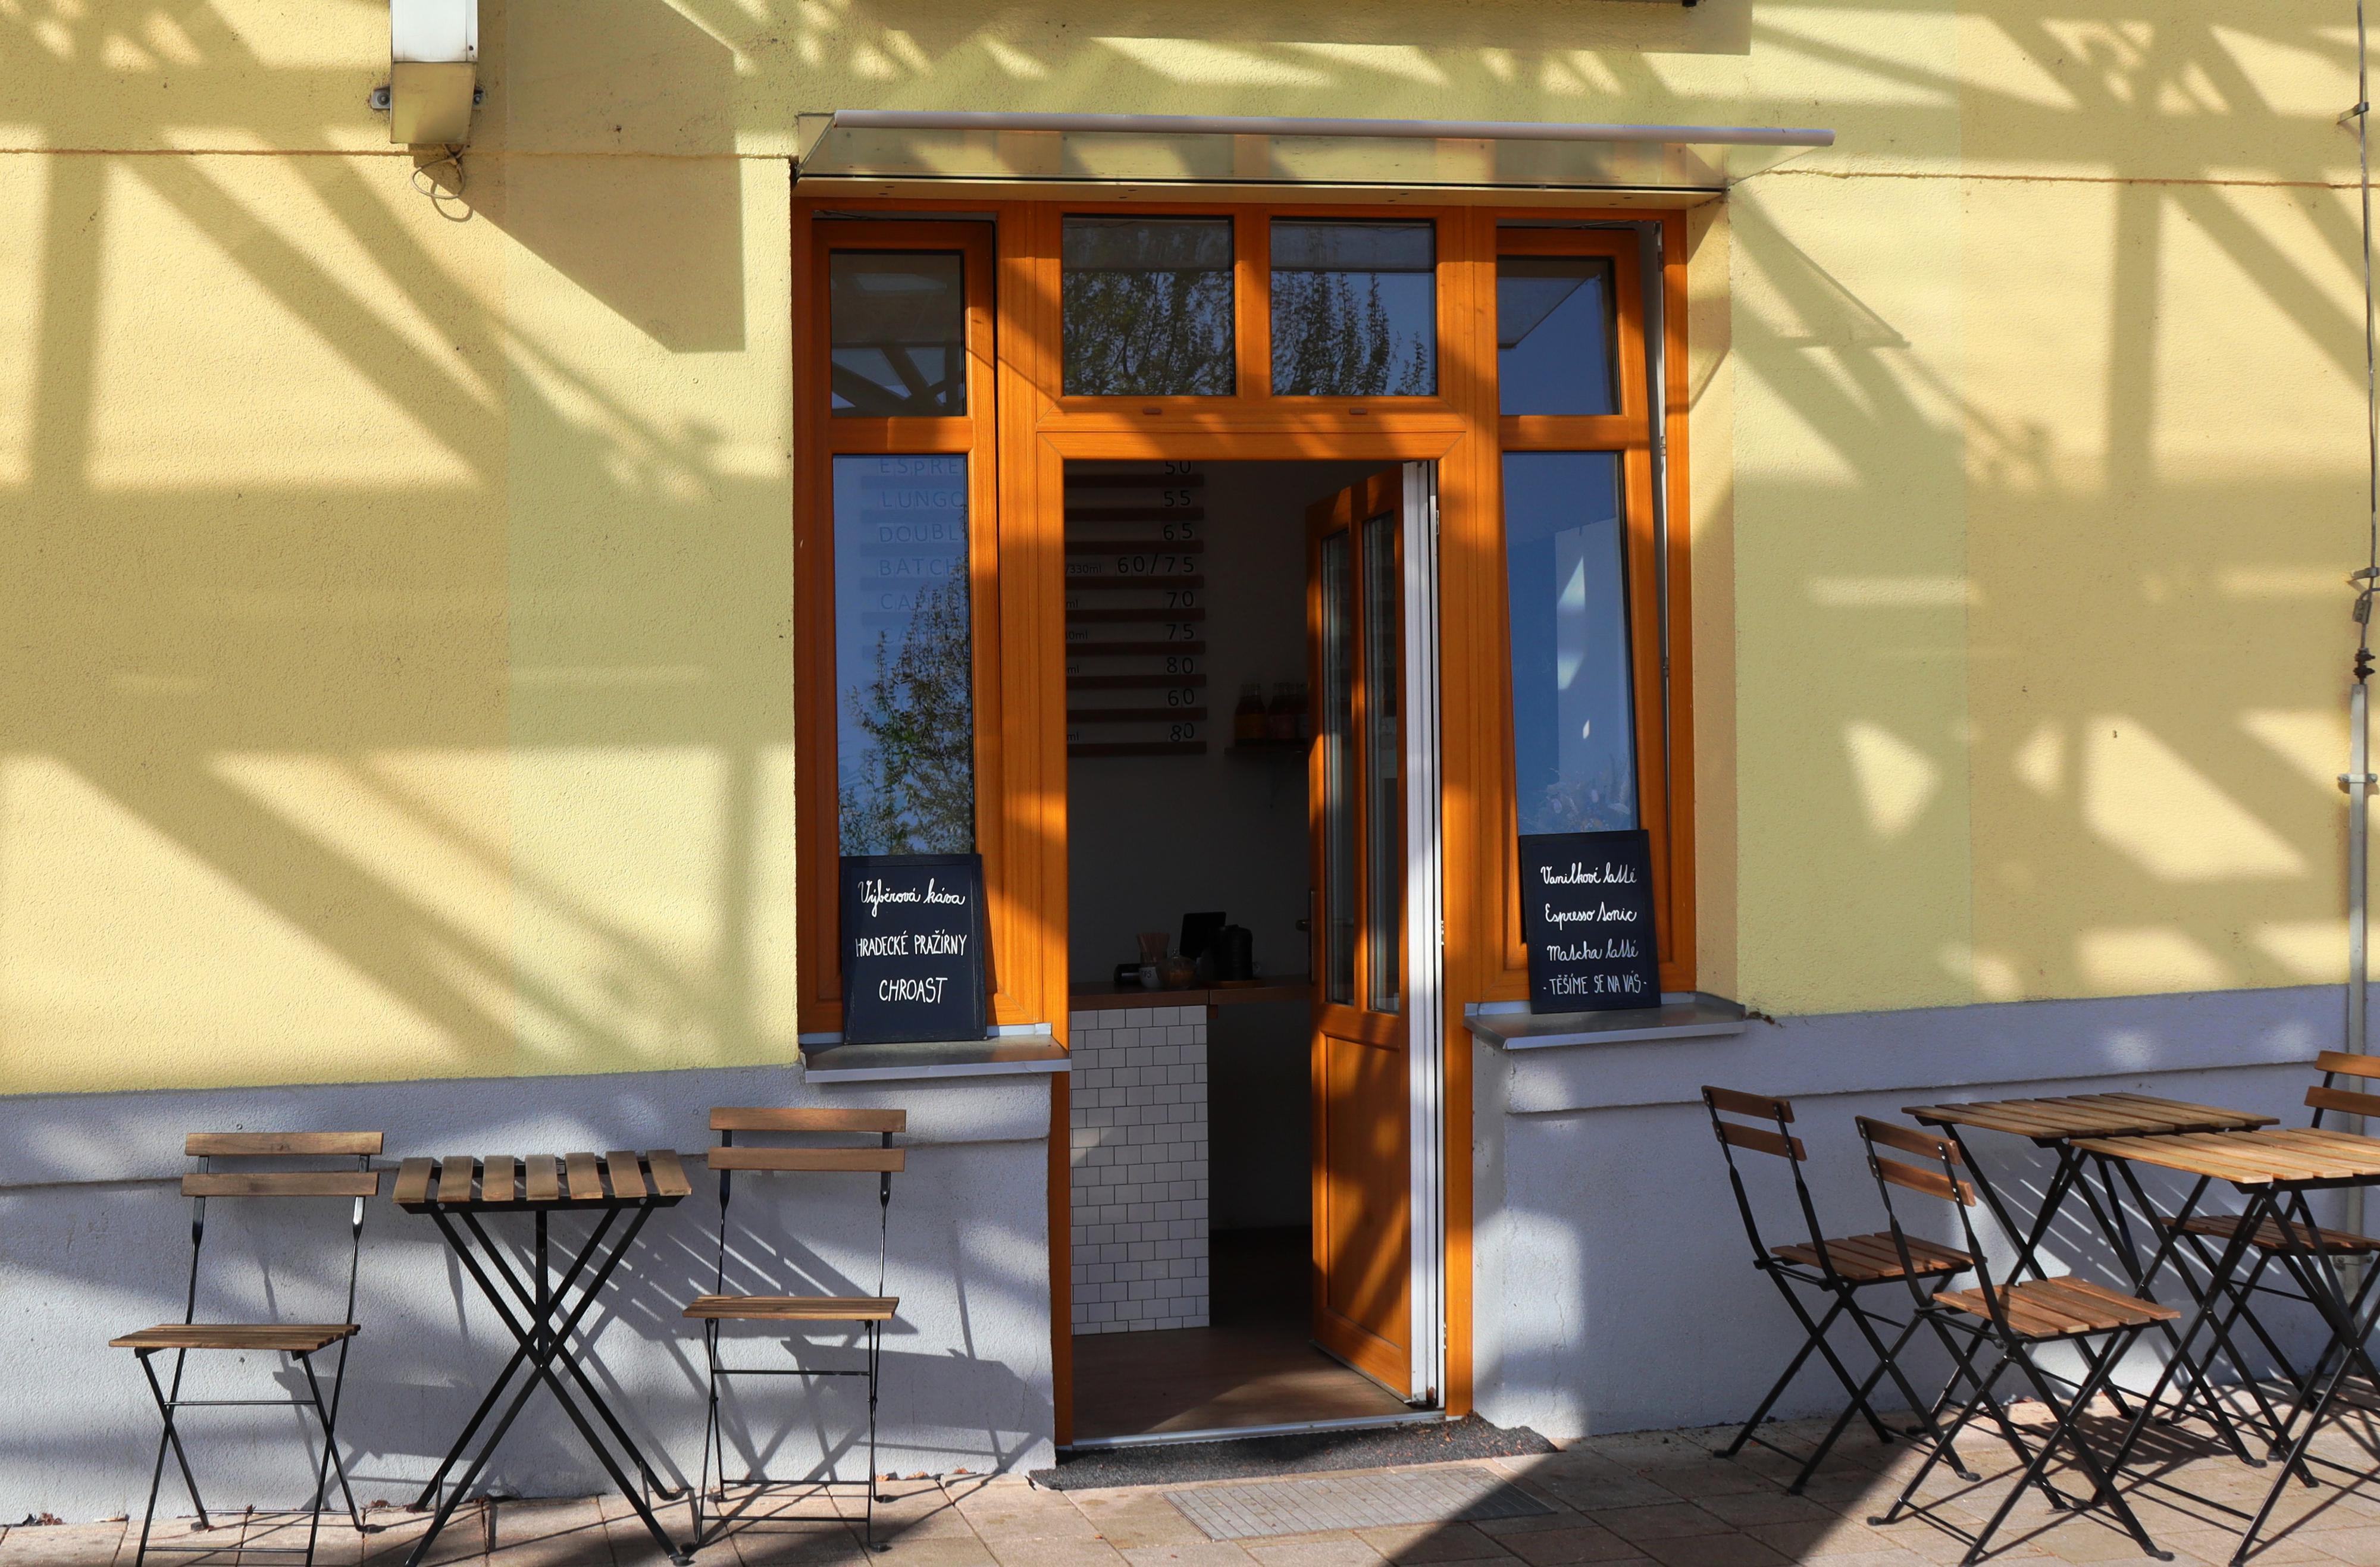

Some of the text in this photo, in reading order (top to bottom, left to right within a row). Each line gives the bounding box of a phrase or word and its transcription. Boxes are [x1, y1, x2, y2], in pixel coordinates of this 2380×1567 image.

[1165, 460, 1191, 475] 50
[1164, 490, 1191, 506] 55
[1163, 523, 1193, 540] 65
[1117, 554, 1194, 574] 60/75
[1166, 591, 1194, 608] 70
[1066, 624, 1194, 640] 0ml 75
[1166, 657, 1194, 674] 80
[1168, 689, 1195, 707] 60
[1170, 723, 1194, 742] 80
[857, 878, 966, 917] Výběrová káva
[1545, 903, 1595, 930] Espresso
[856, 929, 967, 957] HRADECKÉ PRAŽÍRNY
[1547, 941, 1603, 961] Matcha
[879, 977, 948, 1004] CHROAST
[1594, 974, 1604, 994] SE
[1608, 976, 1621, 993] NA
